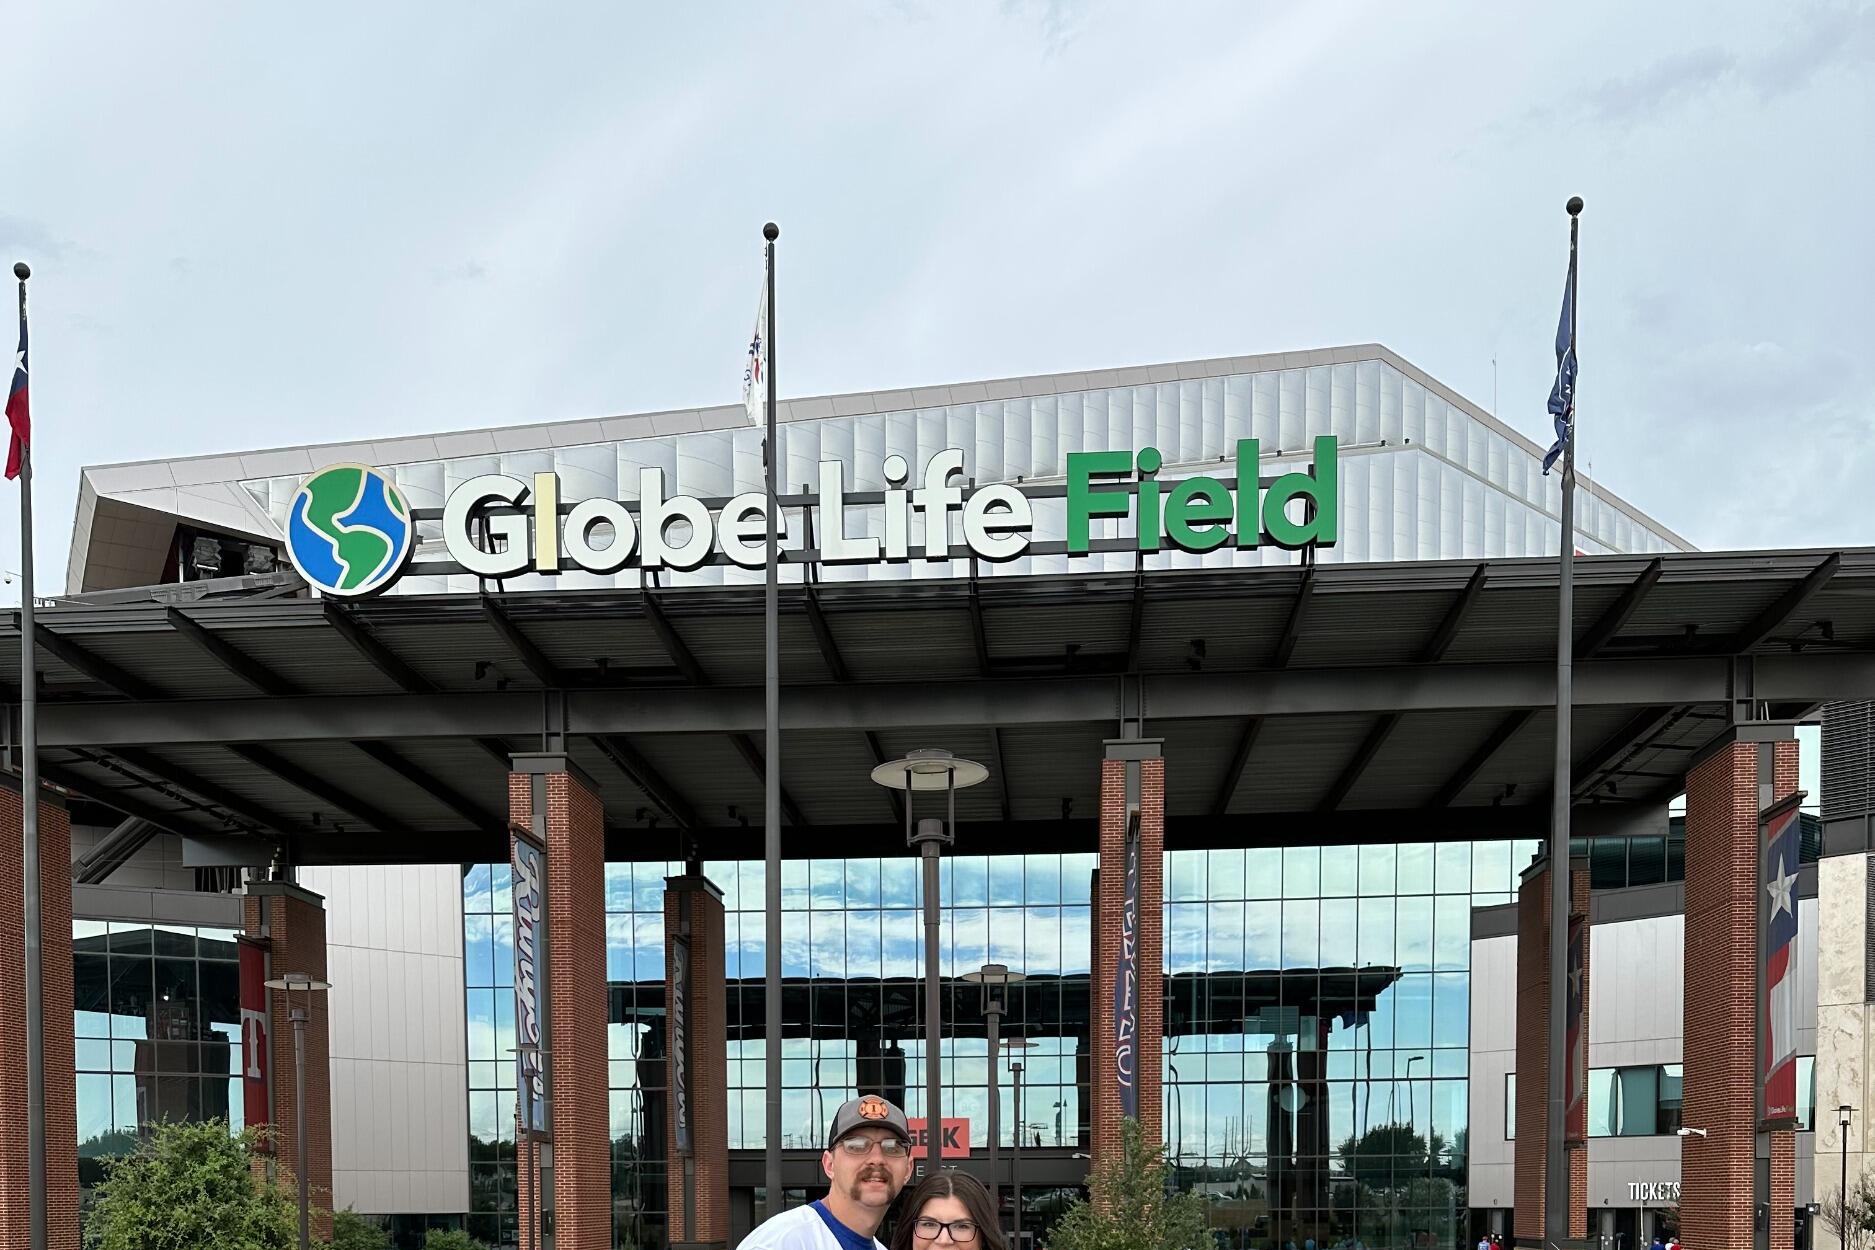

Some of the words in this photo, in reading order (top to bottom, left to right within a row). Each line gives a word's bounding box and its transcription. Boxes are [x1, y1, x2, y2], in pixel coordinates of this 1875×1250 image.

[442, 467, 787, 577] Globe
[818, 447, 1033, 565] Life
[1066, 435, 1339, 558] Field
[241, 1008, 266, 1078] T
[1628, 1181, 1681, 1200] TICKETS
